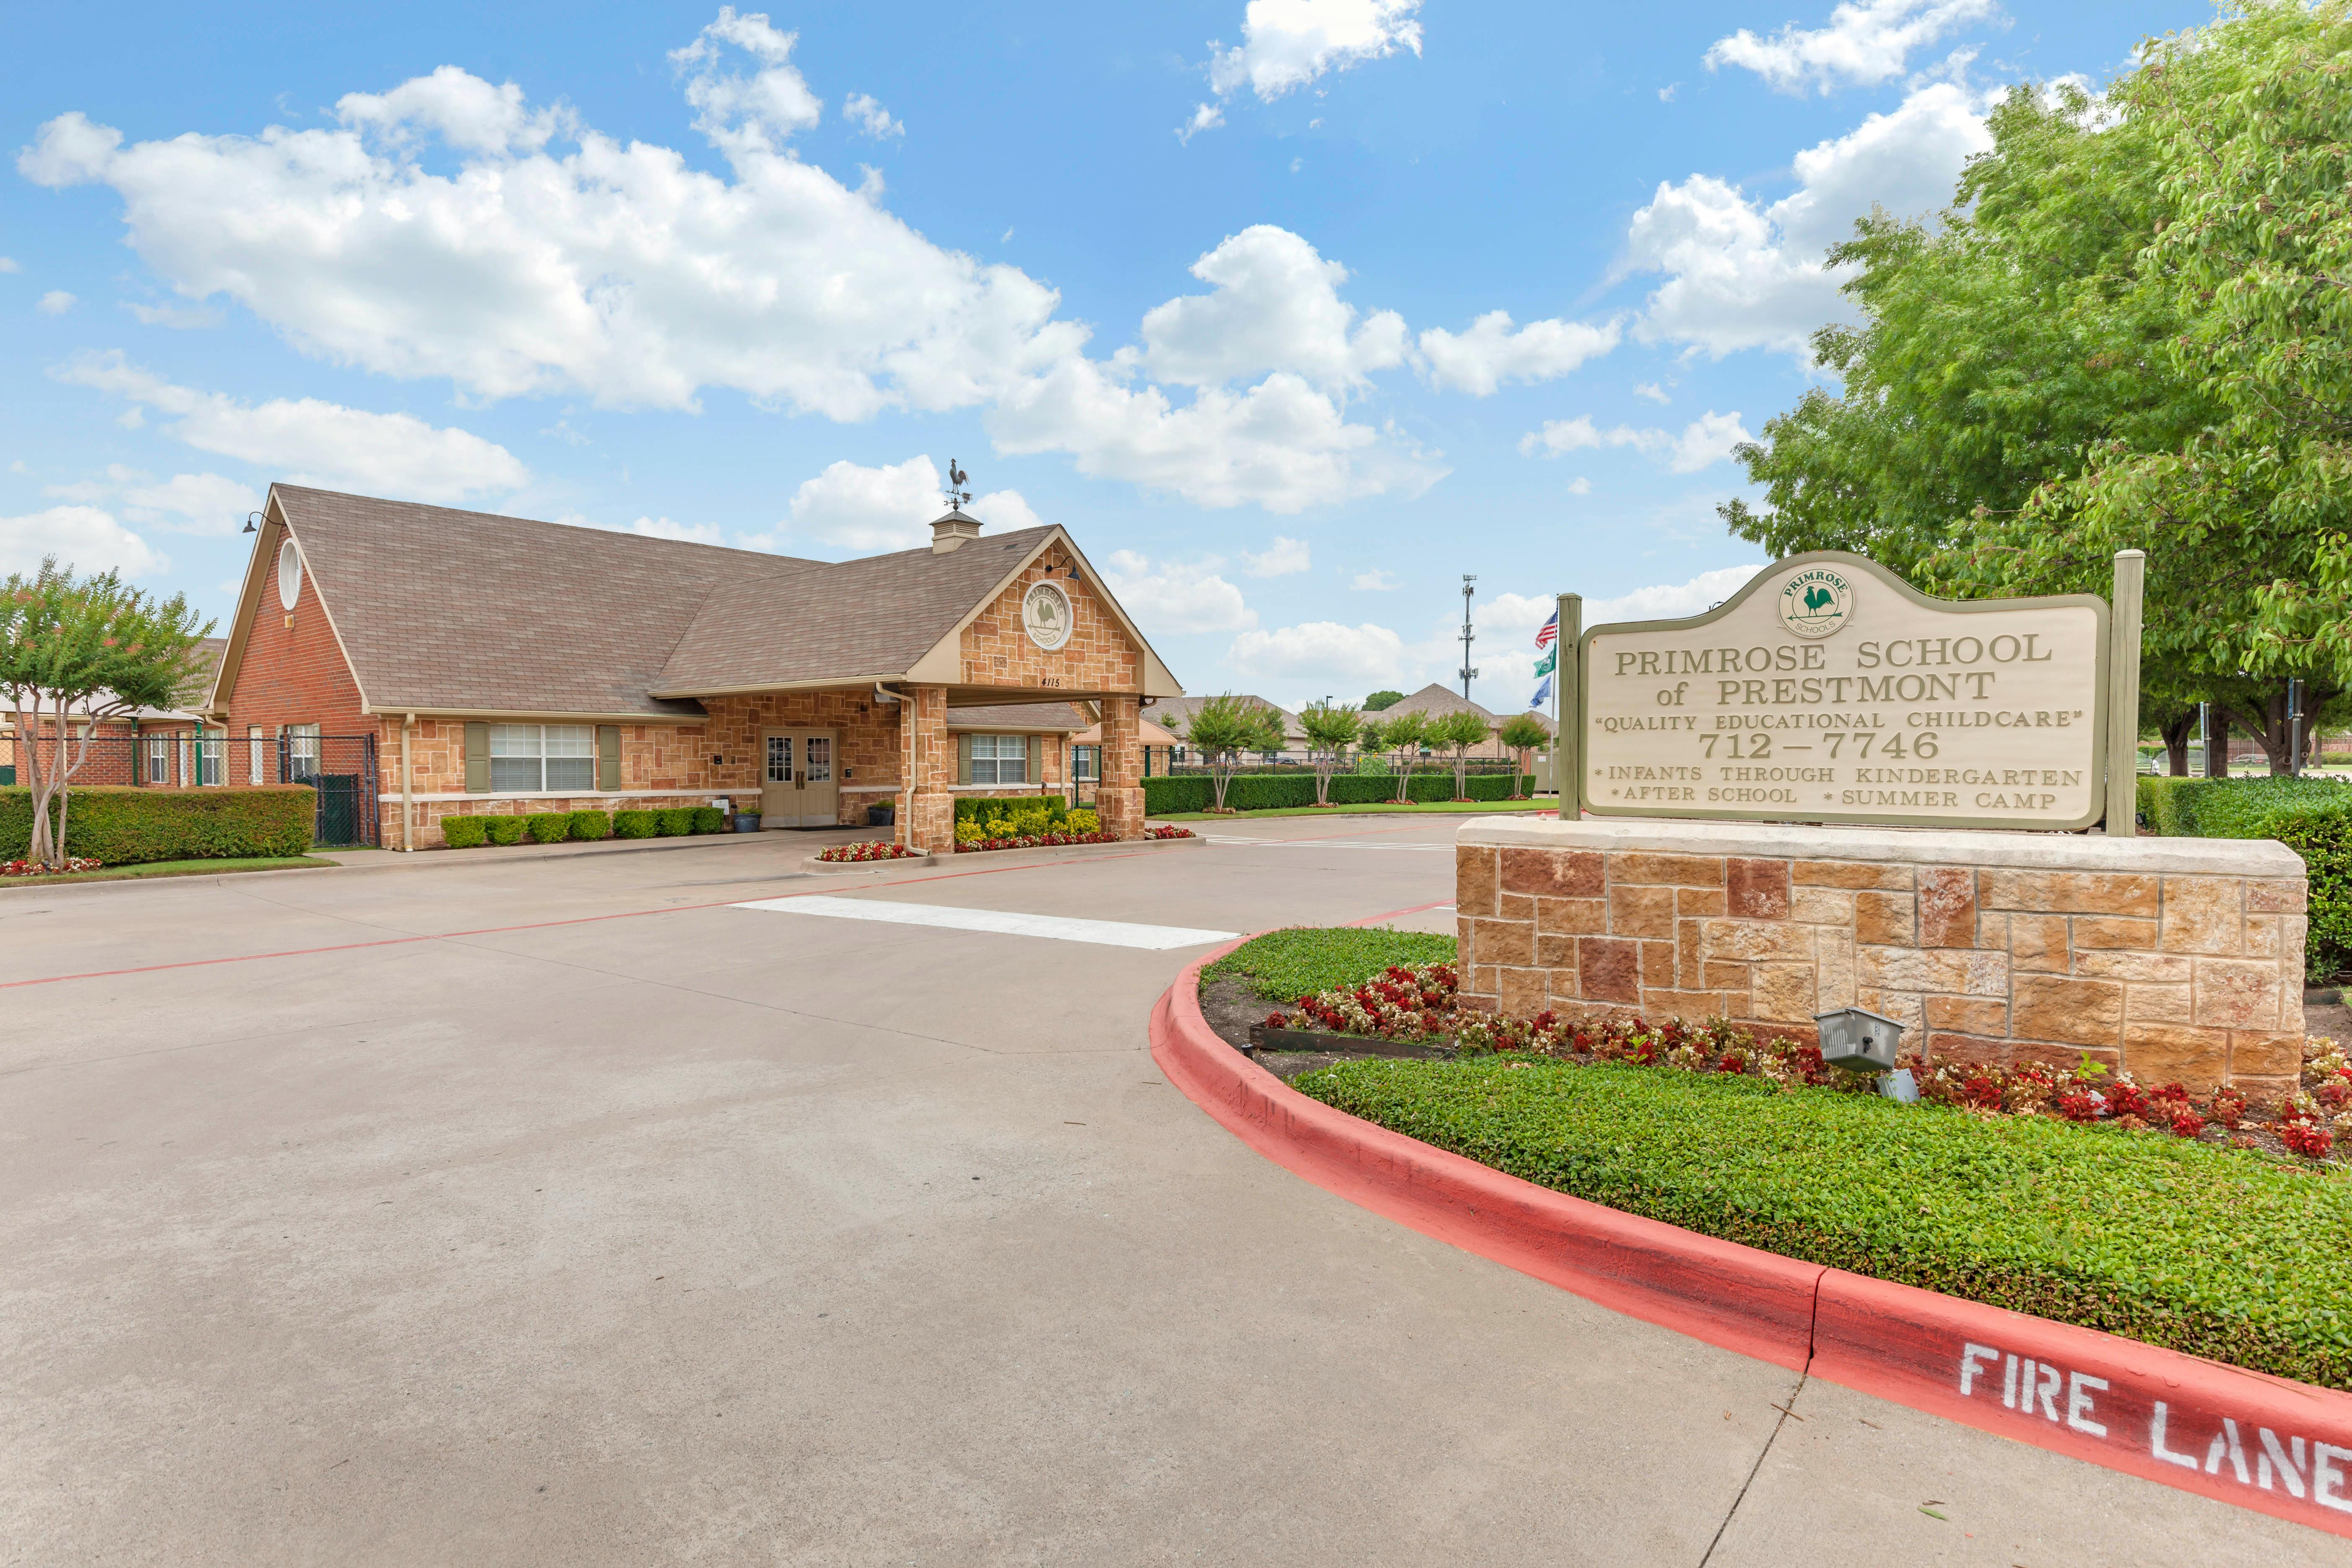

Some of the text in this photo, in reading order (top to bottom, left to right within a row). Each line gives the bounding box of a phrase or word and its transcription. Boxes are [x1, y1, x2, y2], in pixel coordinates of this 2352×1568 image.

[1784, 571, 1848, 597] PRIMROSE
[1026, 588, 1063, 611] PRIMROSE
[1032, 632, 1056, 644] SCHOOLS
[1795, 621, 1836, 633] SCHOOLS
[1615, 633, 2052, 676] PRIMROSE SCHOOL
[1042, 677, 1060, 687] 4115
[1656, 671, 1996, 706] of PRESTMONT
[1715, 712, 1885, 730] EDUCATIONAL
[1609, 766, 2083, 786] INFANTS THROUGH KINDERGARTEN
[1624, 787, 2056, 809] AFTER SCHOOL SUMMER CAMP
[1960, 1343, 2352, 1514] FIRE LANE
